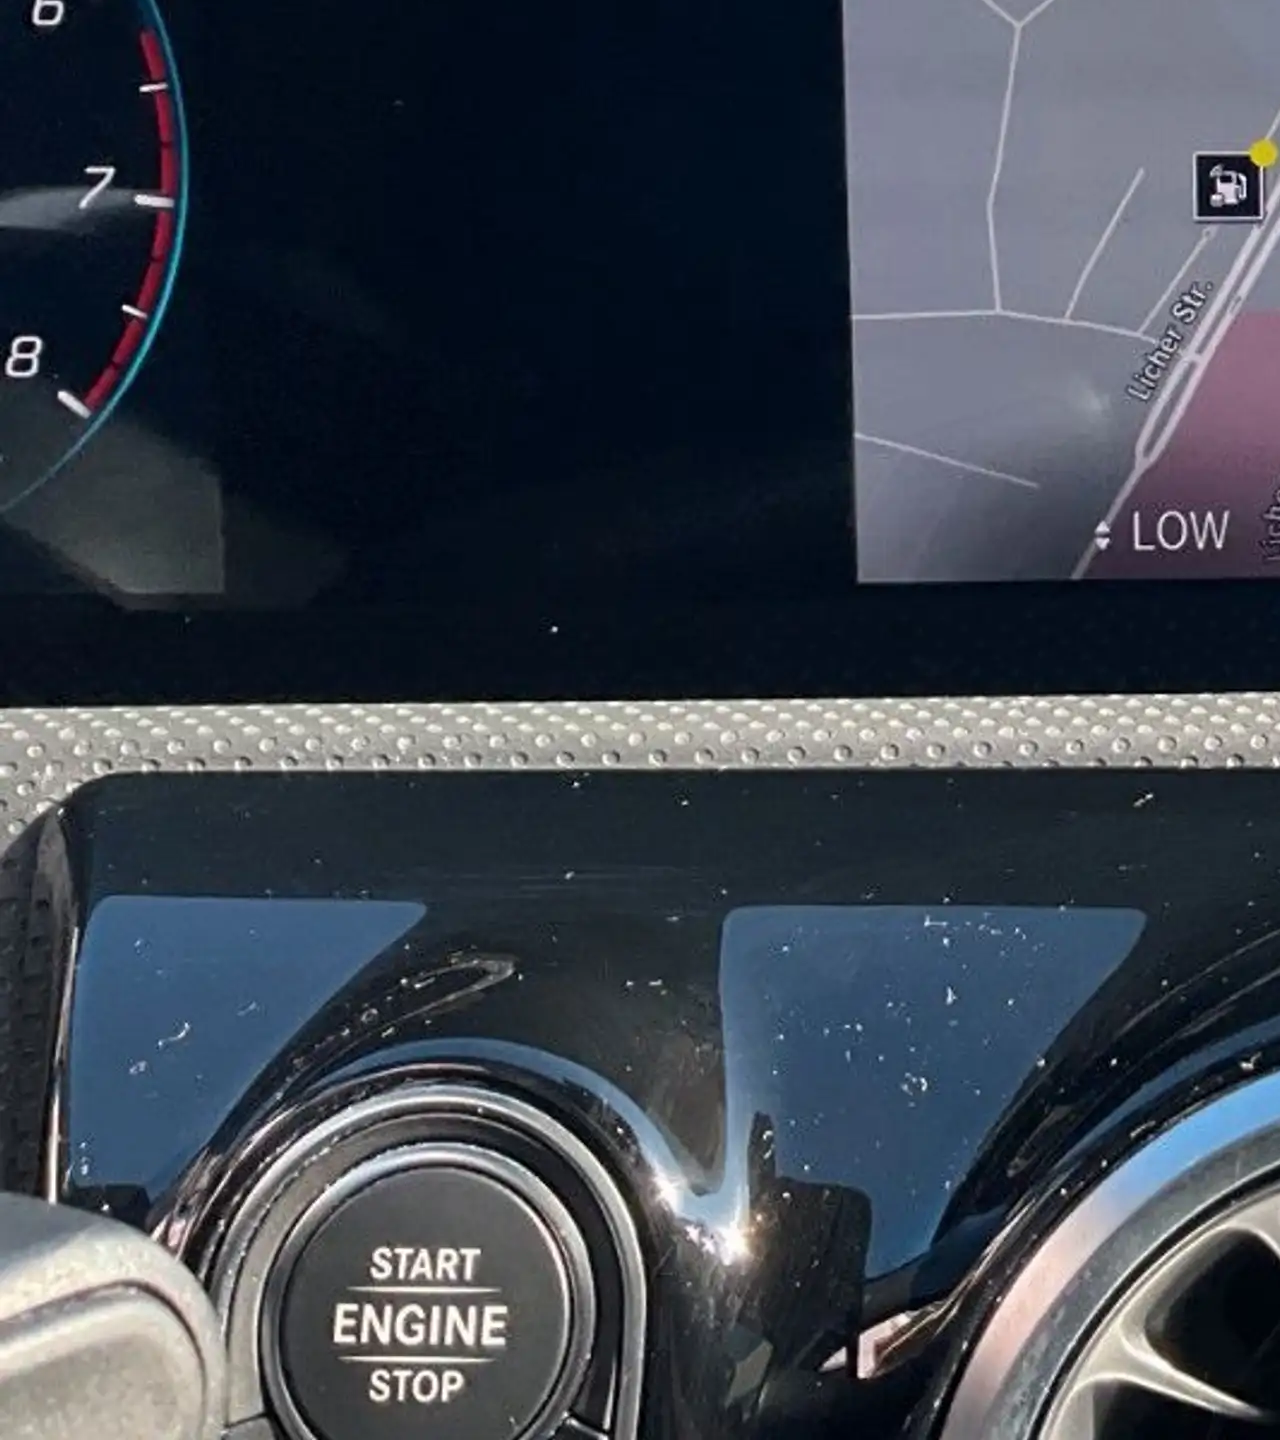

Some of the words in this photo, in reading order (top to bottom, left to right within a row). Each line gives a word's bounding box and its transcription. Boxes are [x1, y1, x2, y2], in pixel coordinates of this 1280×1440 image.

[78, 165, 117, 210] 7
[5, 335, 44, 378] 8
[1126, 324, 1184, 402] Licher
[1171, 281, 1214, 324] Str.
[1132, 510, 1231, 551] LOW
[369, 1246, 482, 1281] START
[332, 1302, 509, 1347] ENGINE
[368, 1368, 465, 1403] STOP
